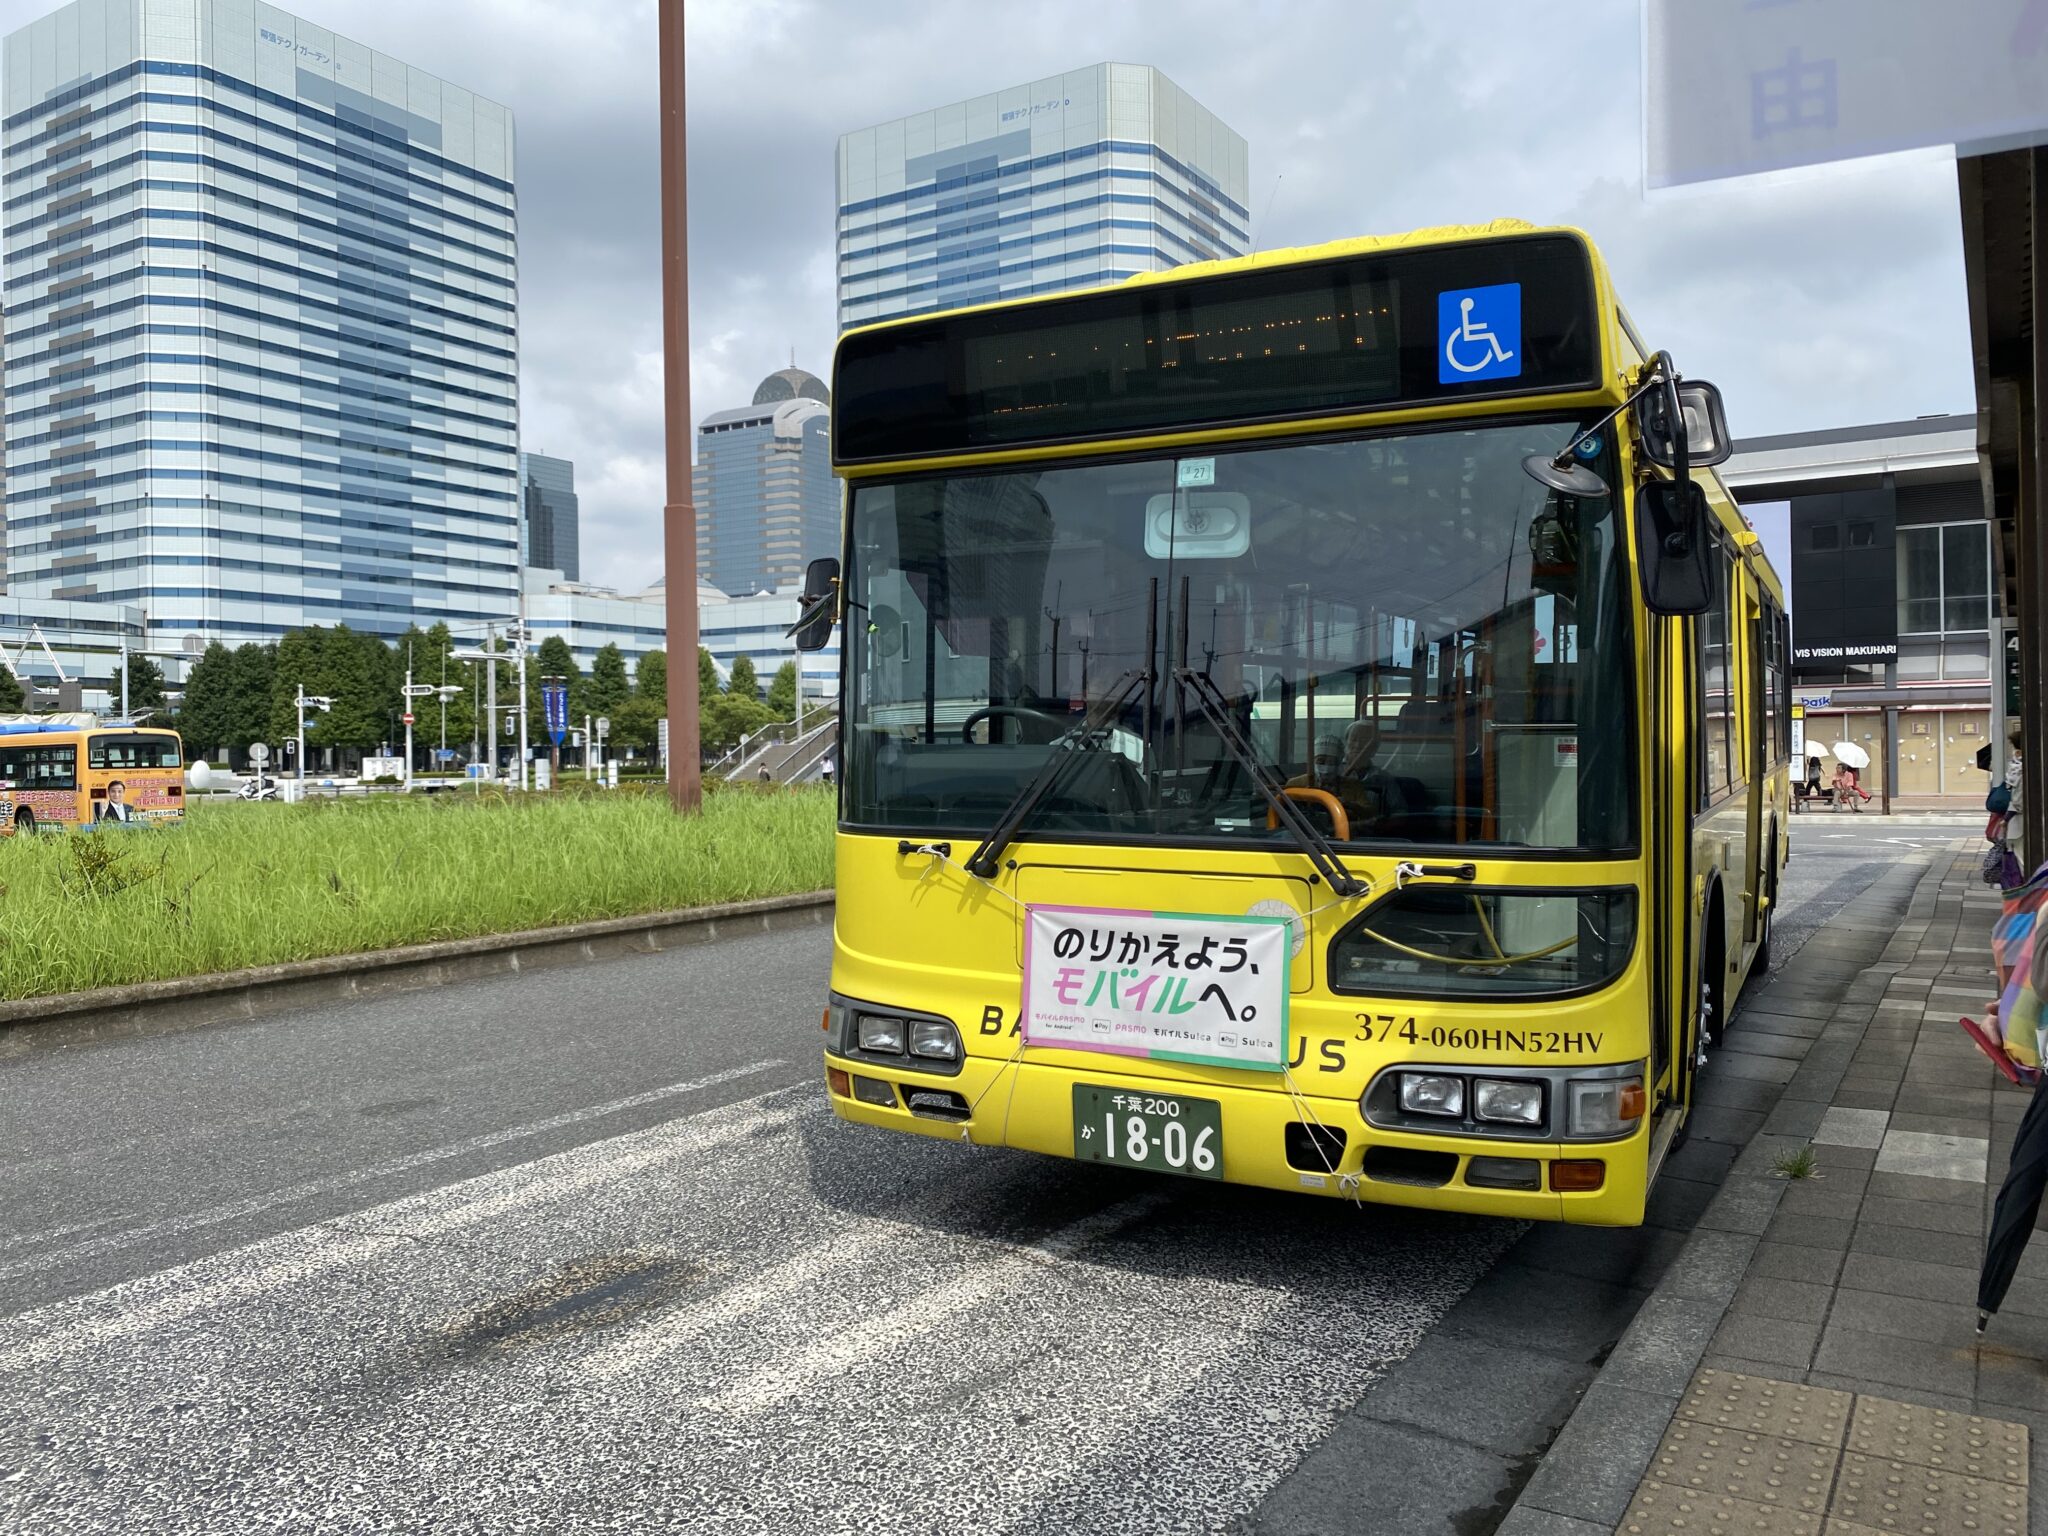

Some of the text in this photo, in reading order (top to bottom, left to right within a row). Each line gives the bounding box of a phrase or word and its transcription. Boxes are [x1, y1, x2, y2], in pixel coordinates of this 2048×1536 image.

[1194, 468, 1205, 478] 27
[1795, 645, 1897, 657] VIS VISION MAKUHARI
[1053, 928, 1259, 975] のりかえよう、
[1053, 968, 1257, 1023] モバイルへ。
[1115, 1023, 1147, 1034] PASMO
[1242, 1037, 1273, 1048] Suica
[1354, 1013, 1604, 1053] 374-060HN52HV
[1111, 1095, 1180, 1117] 千葉200
[1081, 1112, 1215, 1172] か 18-06
